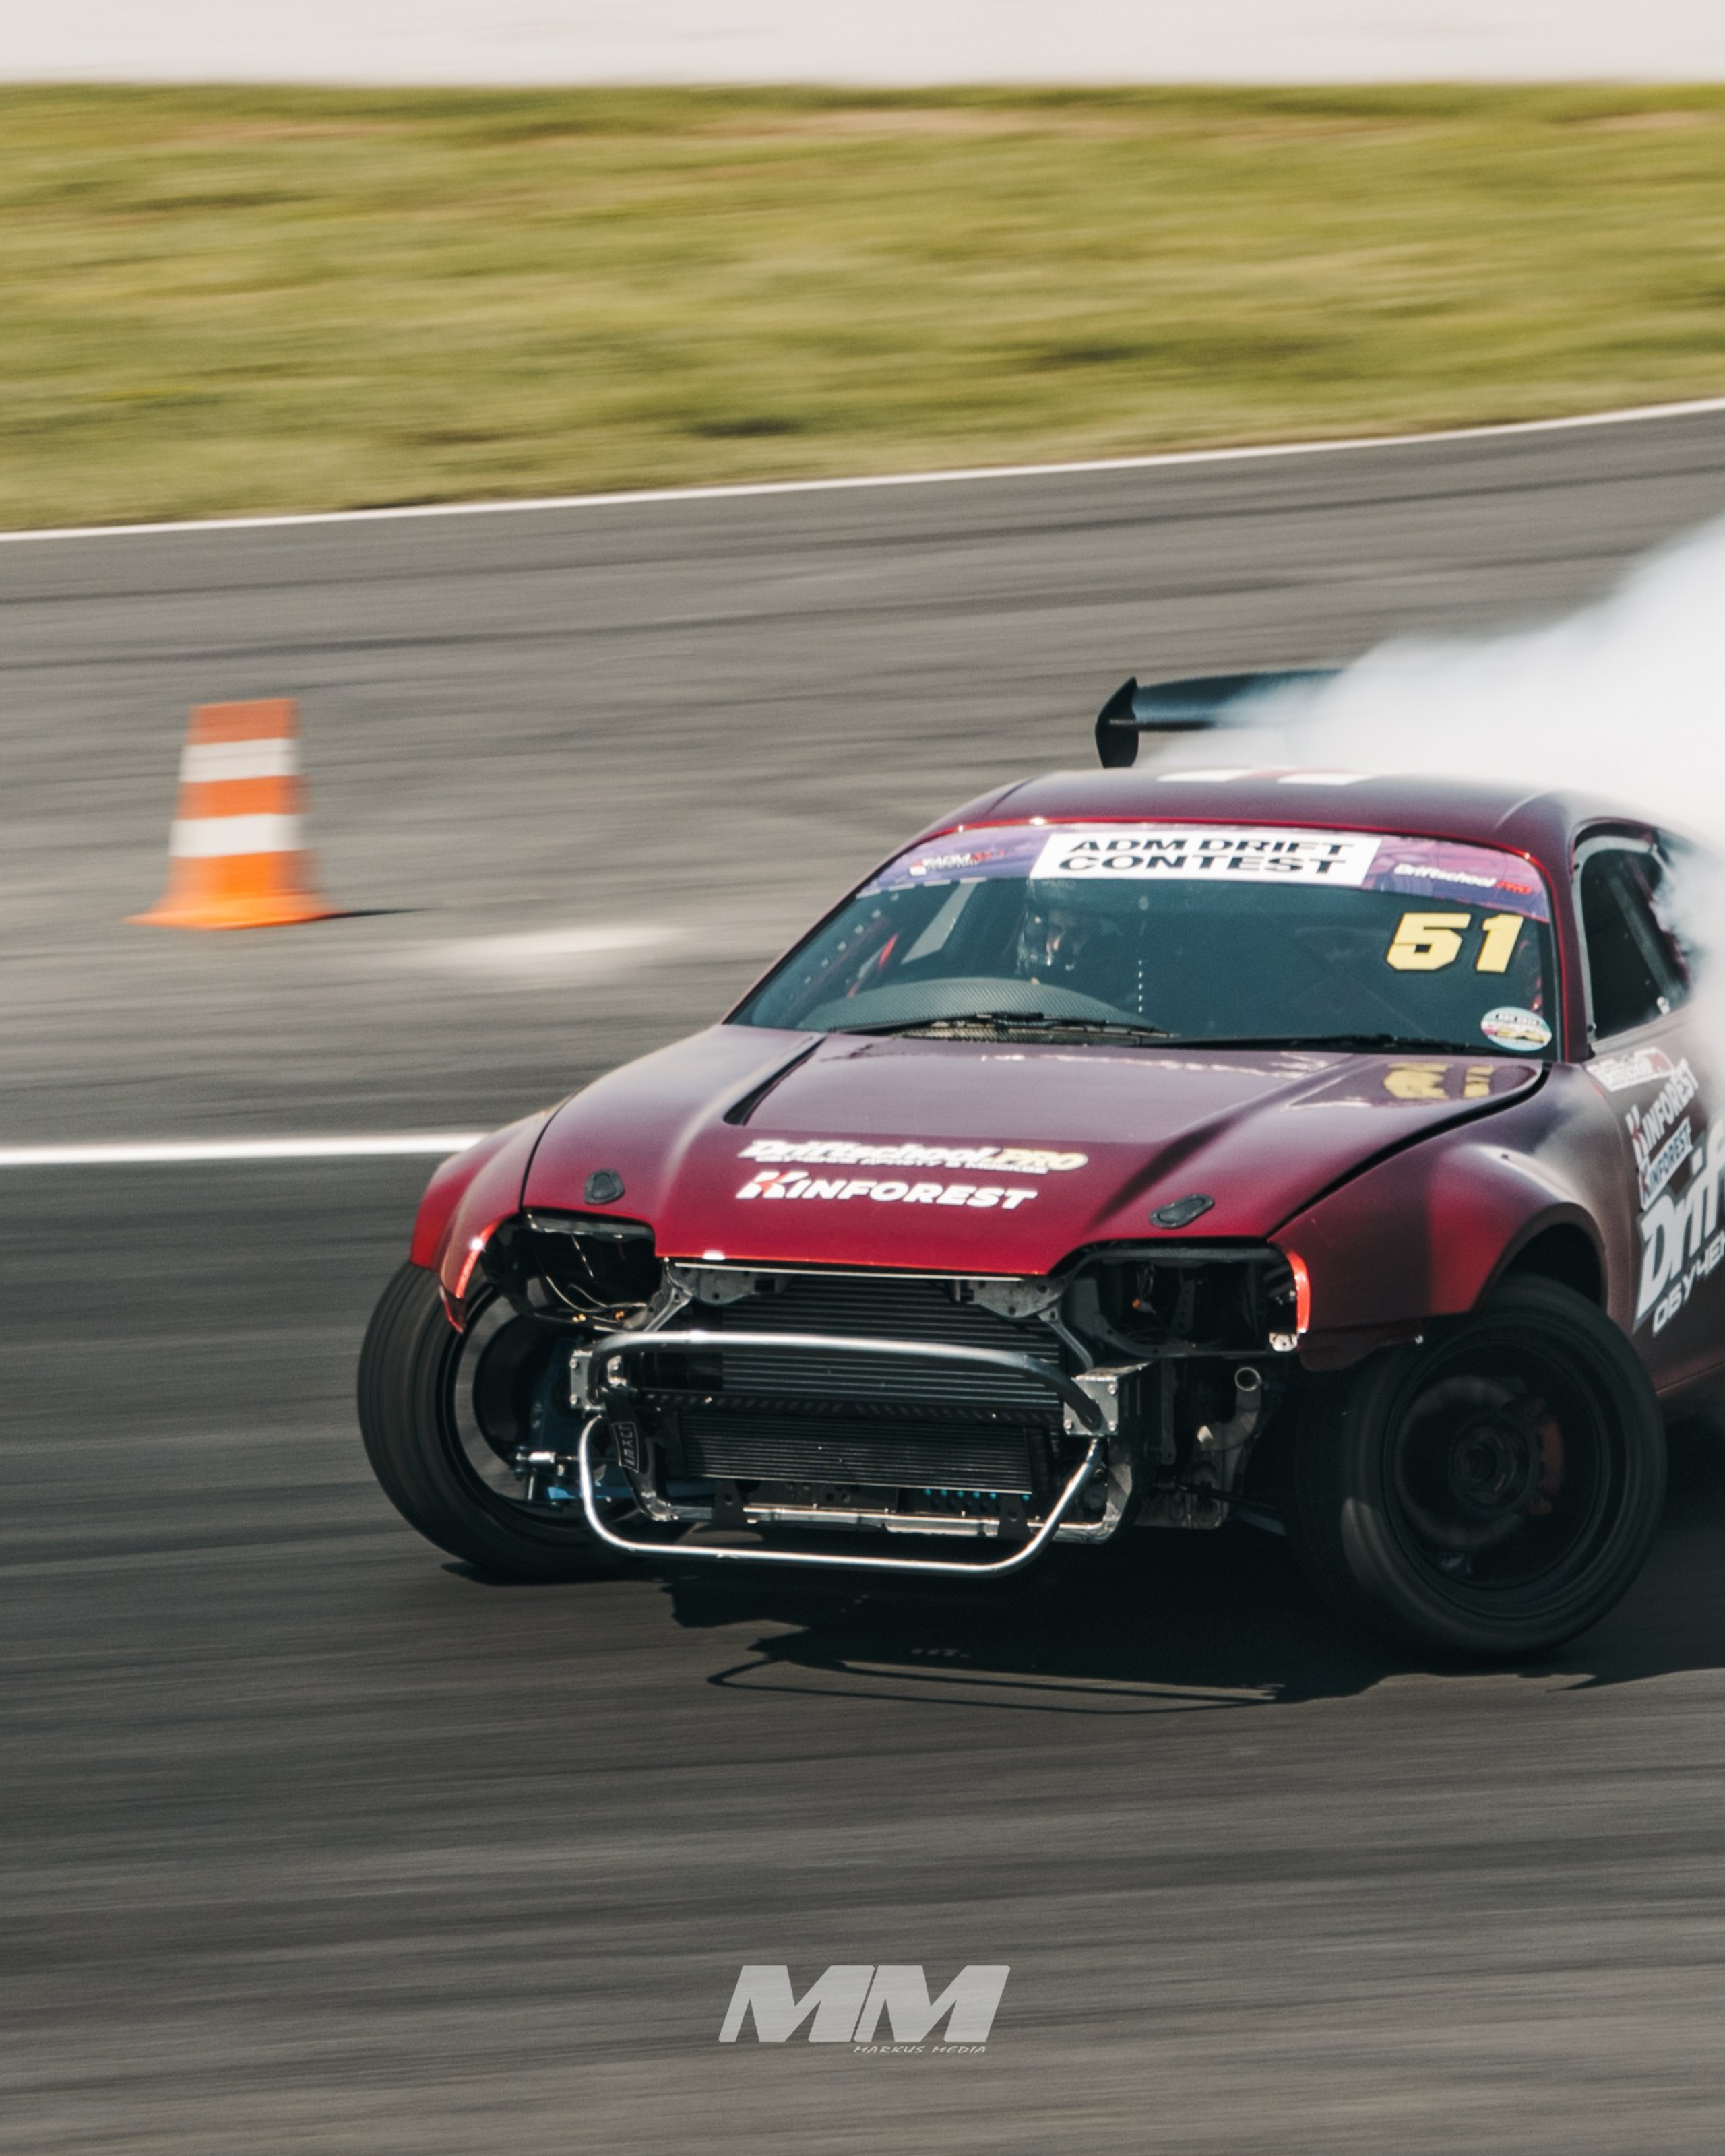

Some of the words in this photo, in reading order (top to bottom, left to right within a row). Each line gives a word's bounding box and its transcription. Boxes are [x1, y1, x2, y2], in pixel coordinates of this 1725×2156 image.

[1058, 855, 1347, 875] CONTEST
[1068, 839, 1189, 853] ADM
[1197, 839, 1354, 856] DRIFT
[1387, 912, 1524, 972] 51
[1625, 1057, 1699, 1169] KINFOREST
[736, 1172, 1038, 1209] KINFOREST
